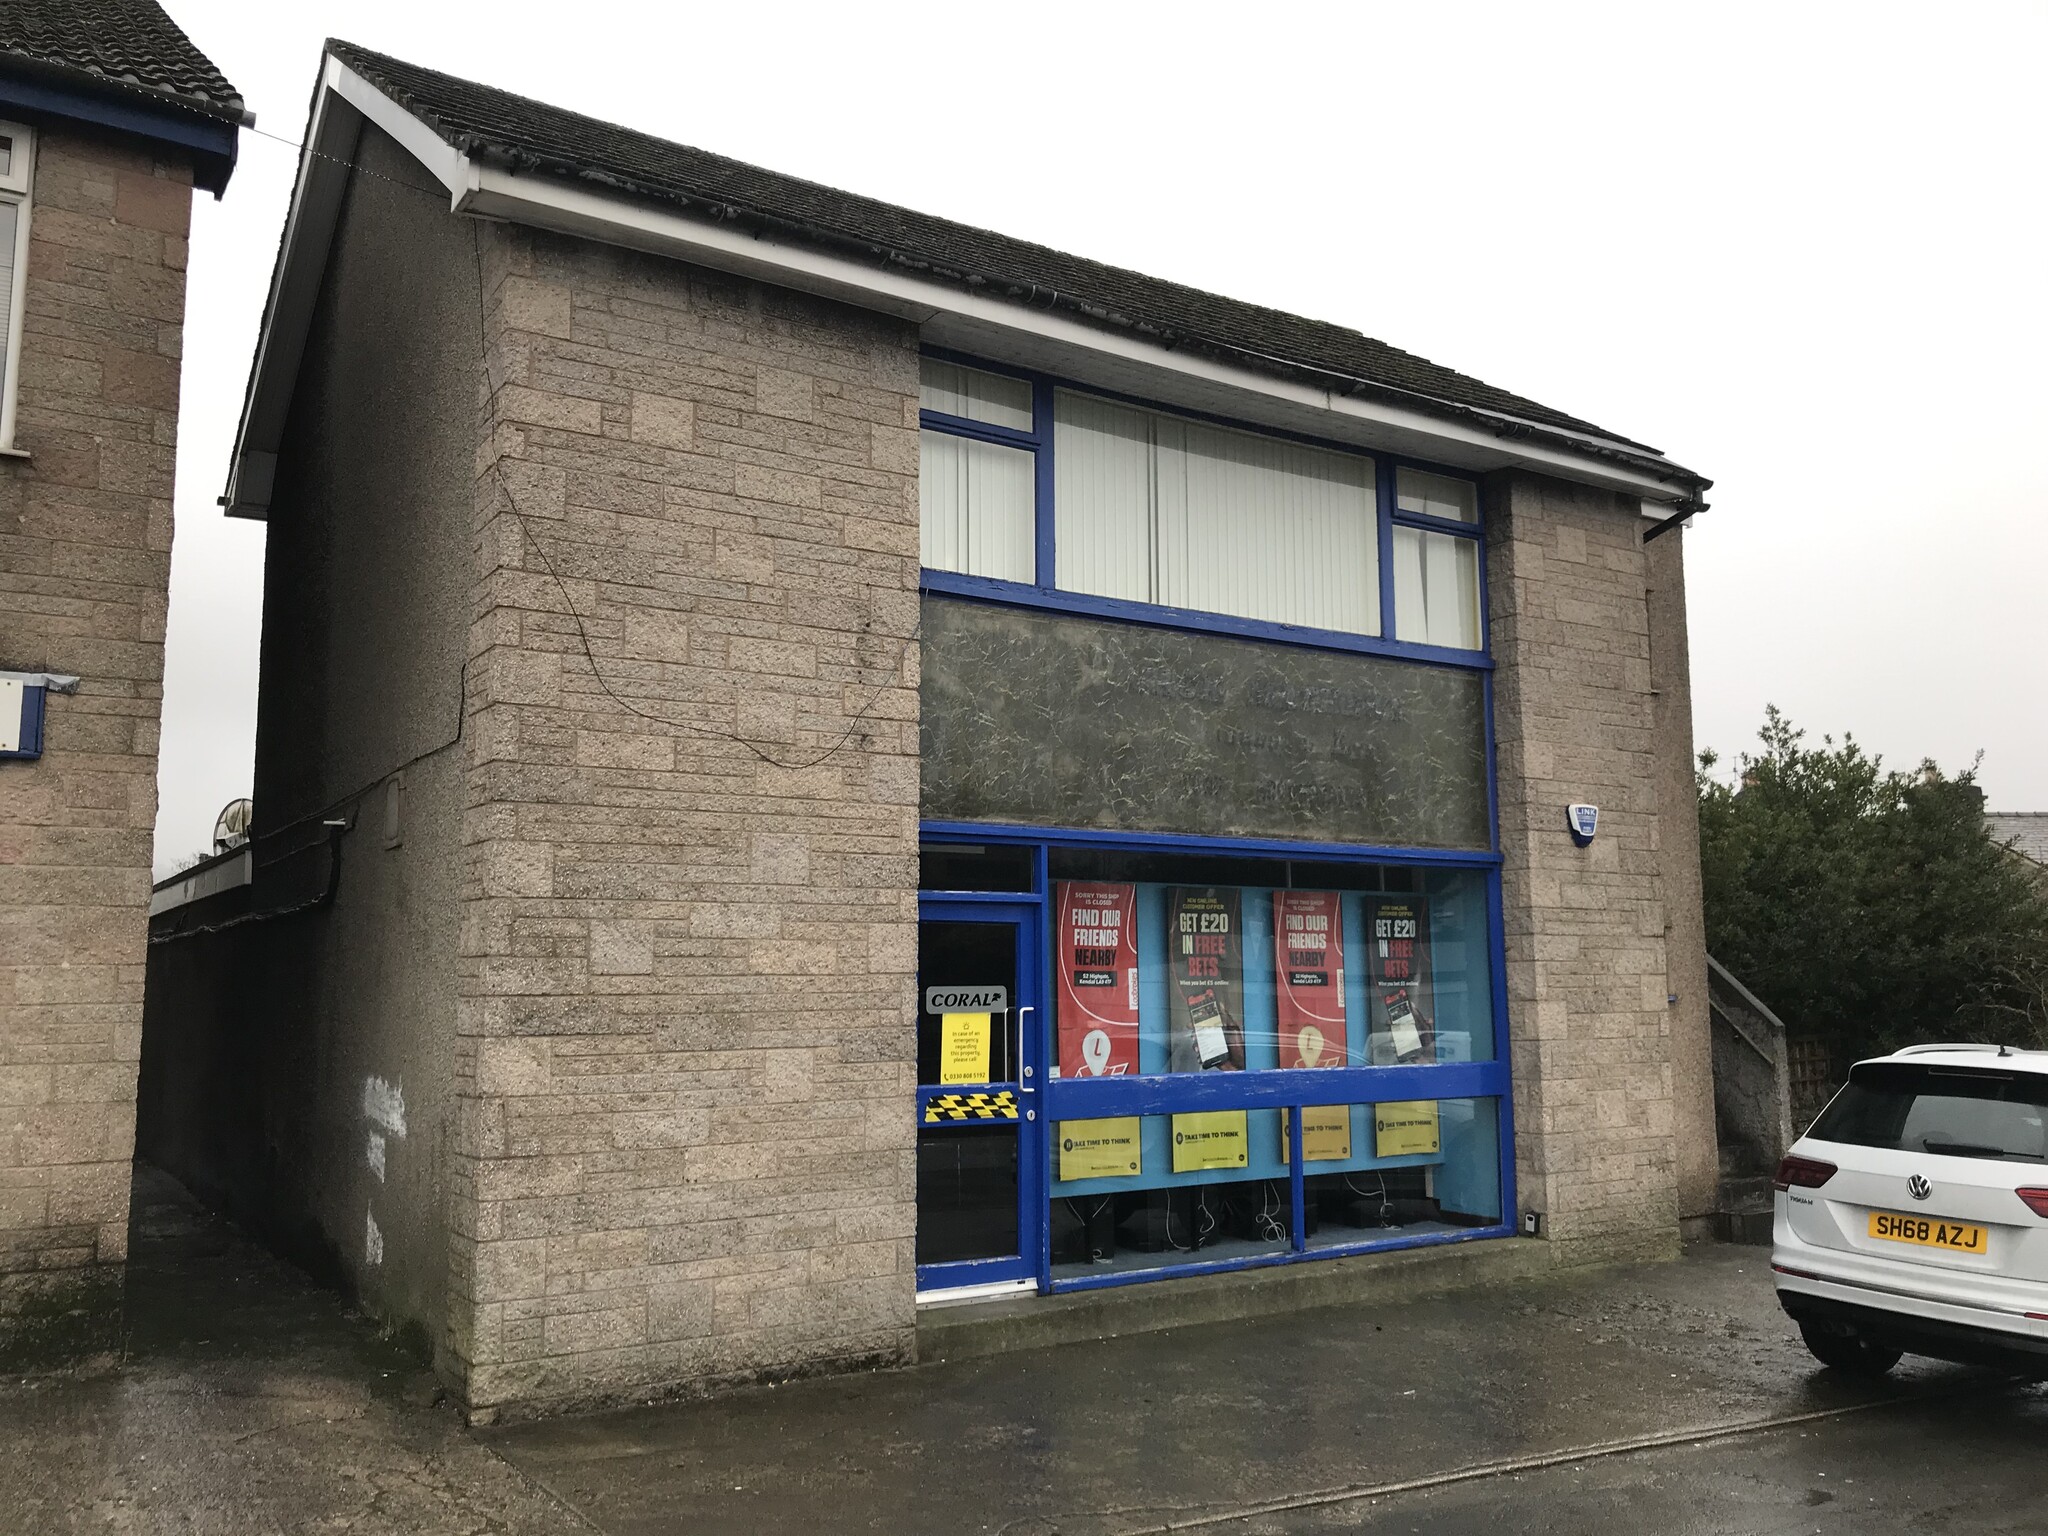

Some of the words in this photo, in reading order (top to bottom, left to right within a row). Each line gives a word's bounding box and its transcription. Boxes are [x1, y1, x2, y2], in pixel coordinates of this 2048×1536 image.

[1577, 808, 1595, 816] LINK
[1072, 908, 1099, 926] FIND
[1101, 909, 1120, 927] OUR
[1180, 913, 1198, 933] GET
[1201, 913, 1229, 933] £20
[1286, 914, 1304, 931] FIND
[1306, 915, 1328, 931] OUR
[1074, 928, 1119, 947] FRIENDS
[1375, 919, 1391, 937] GET
[1394, 920, 1416, 938] £20
[1182, 934, 1193, 955] IN
[1195, 935, 1226, 955] FREE
[1288, 932, 1326, 949] FRIENDS
[1379, 939, 1388, 958] IN
[1389, 940, 1413, 958] FREE
[1075, 949, 1116, 966] NEARBY
[1188, 956, 1218, 977] BETS
[1289, 951, 1326, 967] NEARBY
[1384, 960, 1409, 977] BETS
[931, 993, 991, 1007] CORAL
[1877, 1216, 1929, 1241] SH68
[1936, 1225, 1979, 1248] AZJ
